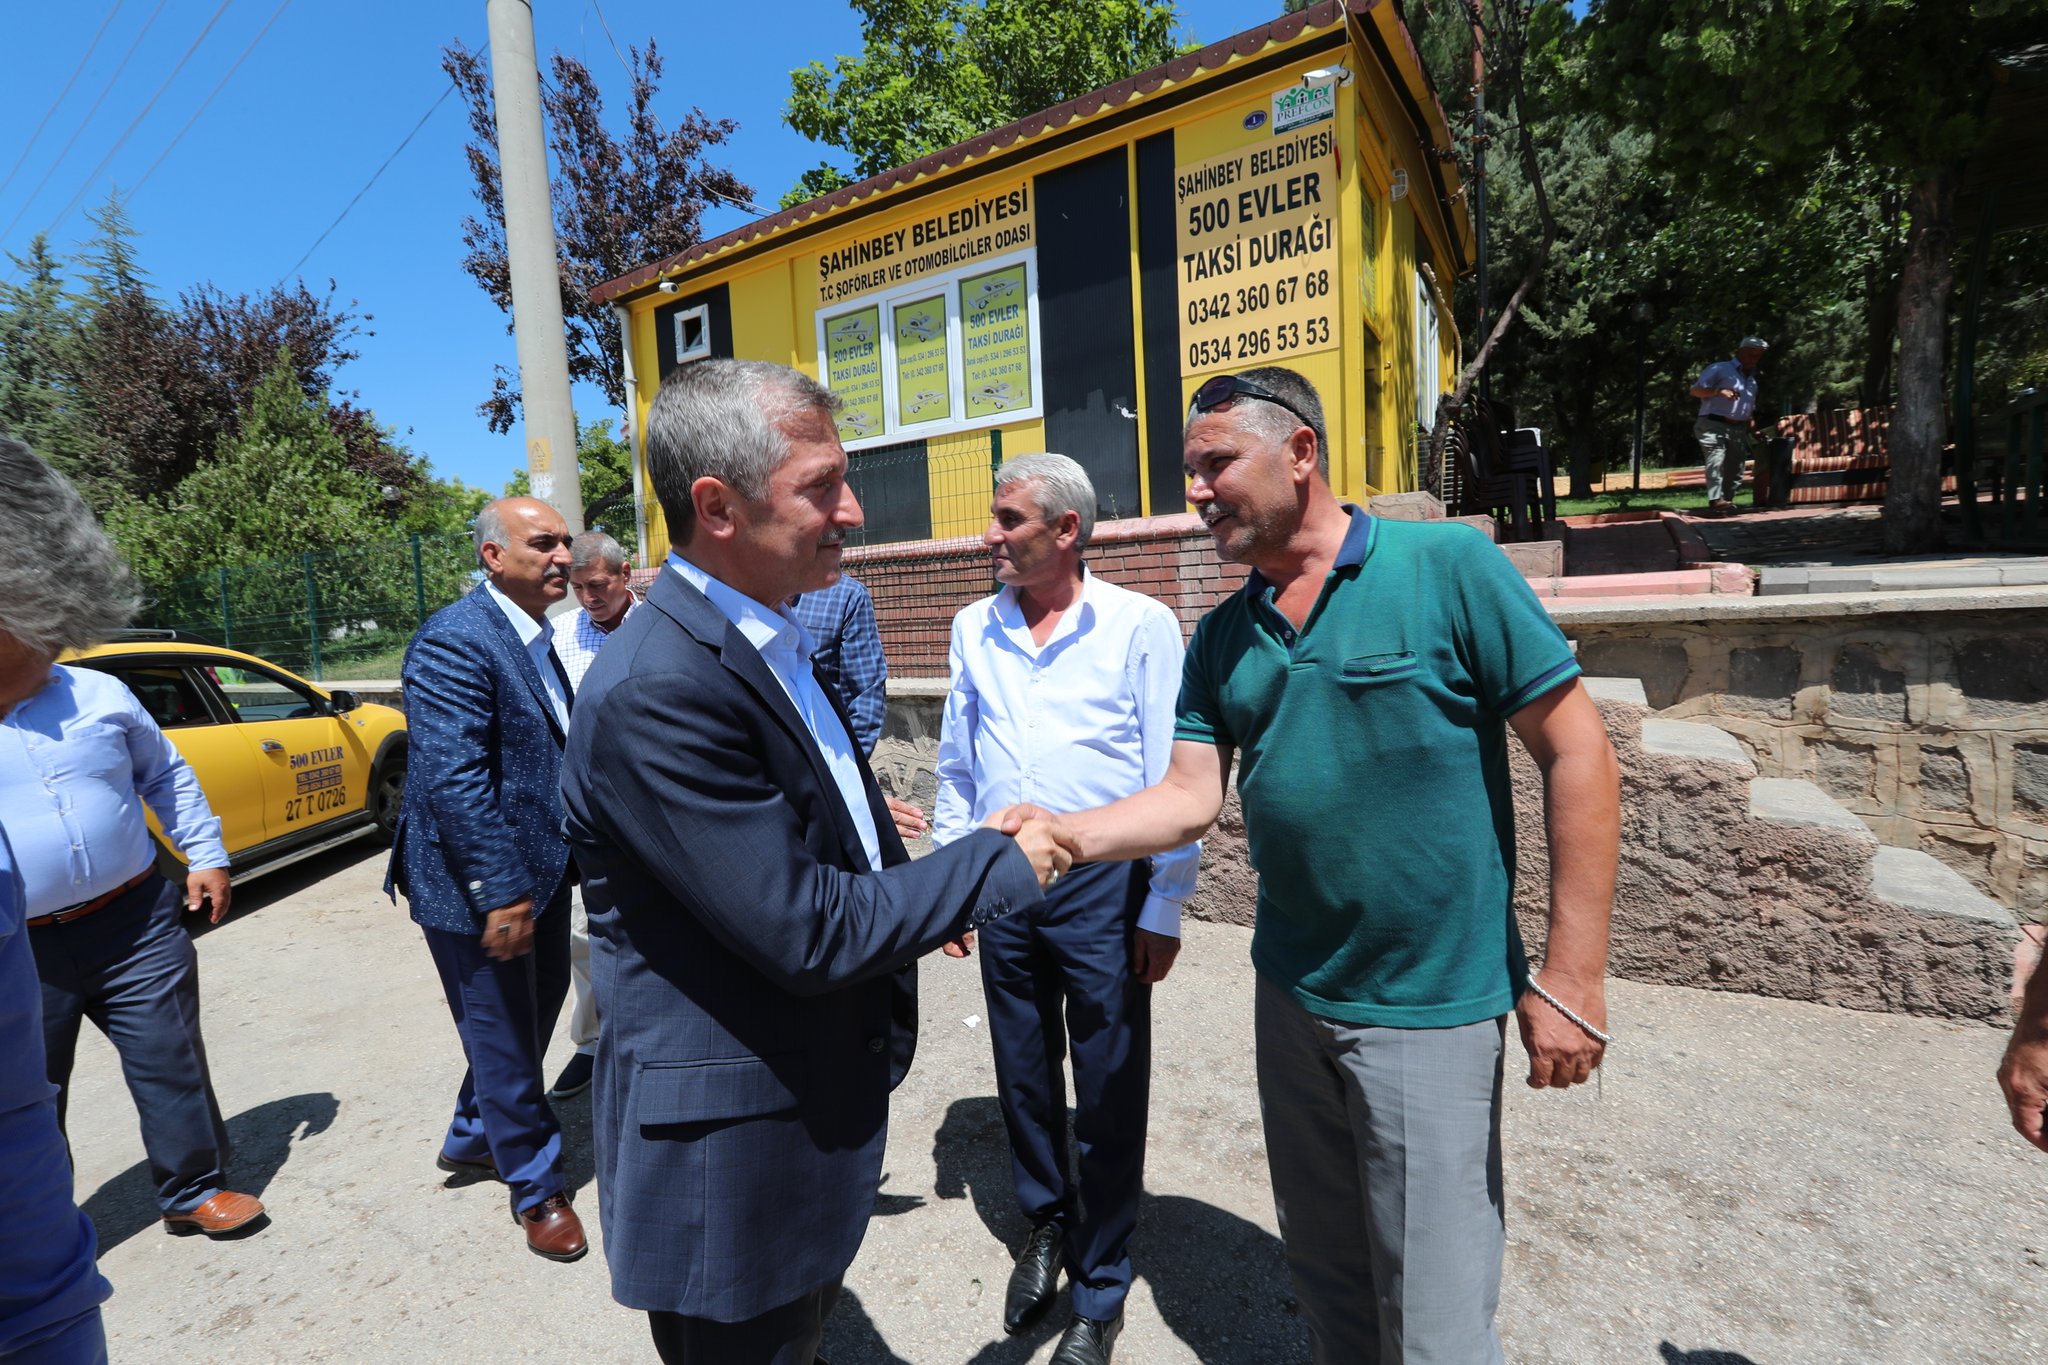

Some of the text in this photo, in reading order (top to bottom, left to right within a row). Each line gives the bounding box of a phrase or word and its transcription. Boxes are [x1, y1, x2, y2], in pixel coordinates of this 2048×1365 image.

[1277, 96, 1331, 122] PREFCON
[1178, 125, 1333, 204] ŞAHİNBEY BELEDİYESİ
[1189, 172, 1321, 236] 500 EVLER
[819, 182, 1028, 282] ŞAHİNBEY BELEDİYESİ
[1184, 212, 1331, 283] TAKSİ DURAĞI
[820, 223, 1030, 302] T.C ŞOFÖRLER VE OTOMOBİLCİLER ODASI
[1188, 269, 1329, 325] 0342 360 67 68
[970, 303, 1019, 330] 500 EVLER
[968, 323, 1024, 350] TAKSİ DURAĞI
[1189, 316, 1330, 368] 0534 296 53 53
[834, 341, 874, 364] 500 EVLER
[990, 350, 999, 361] 534
[1003, 347, 1012, 359] 296
[1012, 346, 1019, 356] 53
[1019, 345, 1026, 355] 53
[832, 360, 878, 382] TAKSİ DURAĞI
[989, 366, 998, 377] 342
[999, 364, 1008, 375] 360
[1008, 363, 1015, 373] 67
[1015, 362, 1022, 372] 68
[290, 746, 344, 770] 500 EVLER
[286, 786, 346, 821] 27 T 0726
